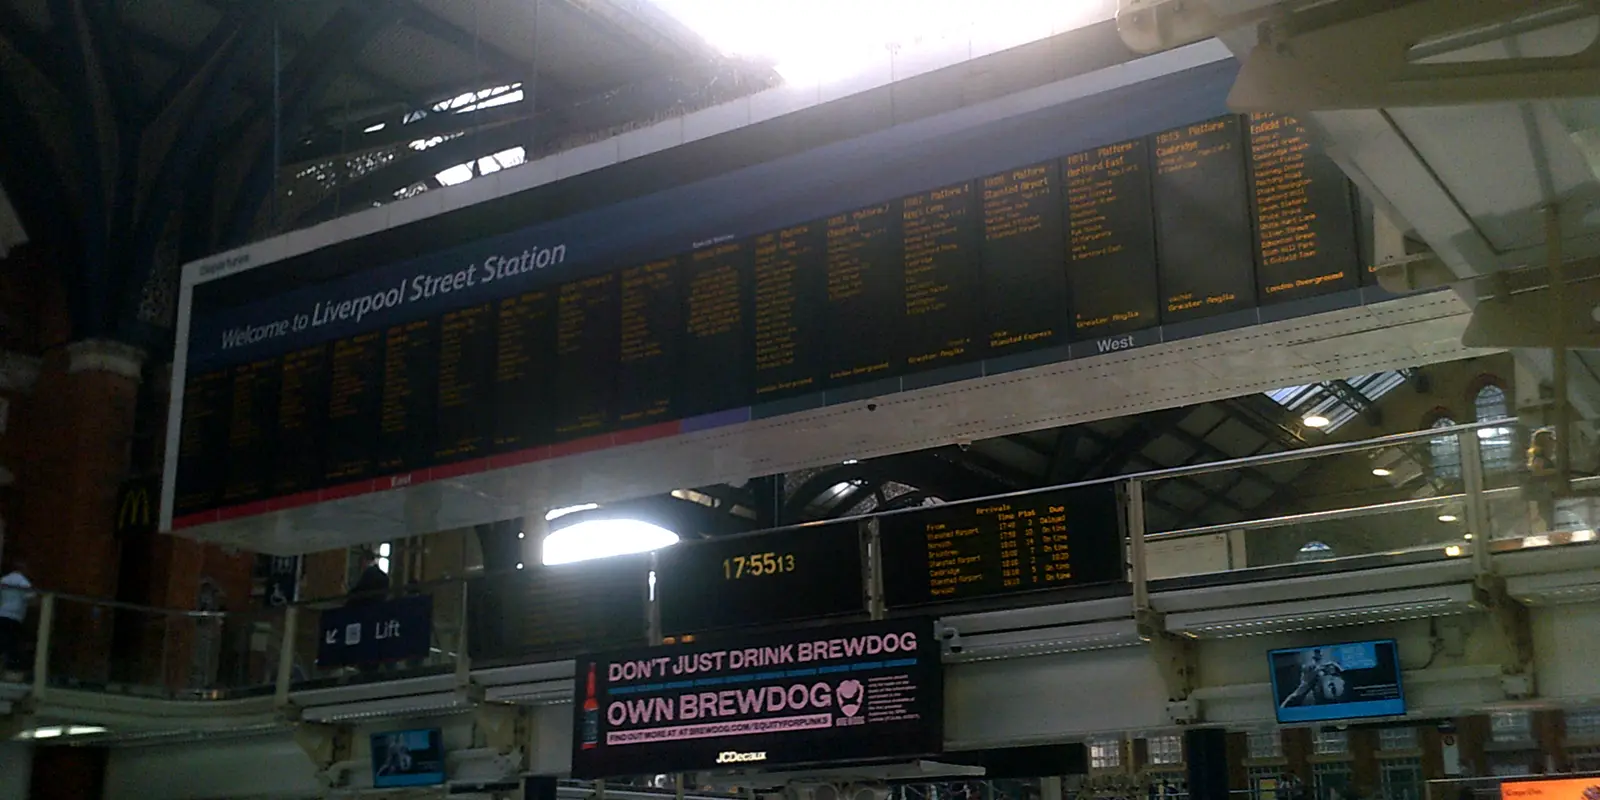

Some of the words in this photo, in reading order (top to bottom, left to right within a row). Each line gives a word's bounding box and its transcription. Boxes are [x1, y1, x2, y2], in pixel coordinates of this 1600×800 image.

[1188, 121, 1225, 137] Platform
[1097, 141, 1133, 157] Platform
[1155, 141, 1199, 158] Cambridge
[1067, 160, 1103, 177] Hertford
[1105, 155, 1125, 168] East
[984, 184, 1019, 200] Stansted
[1020, 177, 1049, 191] Airport
[1265, 283, 1294, 293] London
[1295, 271, 1345, 285] Overground
[221, 319, 290, 350] Welcome
[292, 313, 308, 332] to
[312, 279, 407, 327] Liverpool
[409, 263, 475, 302] Street
[482, 243, 566, 283] Station
[1167, 300, 1203, 312] Greater
[1206, 293, 1236, 304] Anglia
[1076, 317, 1109, 328] Greater
[1112, 311, 1140, 321] Anglia
[990, 335, 1022, 347] Stansted
[1023, 329, 1053, 341] Express
[1097, 335, 1134, 353] West
[926, 523, 946, 531] From
[998, 512, 1015, 521] Time
[1018, 508, 1036, 518] Plat
[1049, 505, 1065, 514] Due
[976, 504, 1011, 515] Arrivals
[927, 530, 954, 540] Stansted
[955, 527, 980, 536] Airport
[1039, 514, 1066, 524] Delayed
[1042, 525, 1051, 533] On
[1052, 523, 1067, 532] time
[1043, 535, 1052, 543] On
[1053, 533, 1068, 542] time
[928, 558, 956, 568] Stansted
[957, 555, 981, 564] Airport
[1053, 543, 1069, 551] time
[929, 567, 961, 577] Cambridge
[930, 576, 957, 587] Stansted
[958, 573, 983, 583] Airport
[1045, 564, 1054, 572] On
[1055, 562, 1070, 571] time
[1045, 573, 1055, 581] On
[1056, 571, 1072, 580] time
[375, 619, 400, 640] Lift
[607, 656, 670, 682] DON'T
[672, 650, 727, 675] JUST
[729, 643, 795, 671] DRINK
[797, 631, 918, 660] BREWDOG
[606, 697, 675, 727] OWN
[678, 682, 833, 721] BREWDOG
[609, 733, 627, 743] FIND
[627, 732, 644, 742] OUT
[644, 730, 666, 740] MORE
[667, 729, 677, 739] AT
[678, 728, 688, 738] AT
[715, 751, 767, 764] JCDecaux
